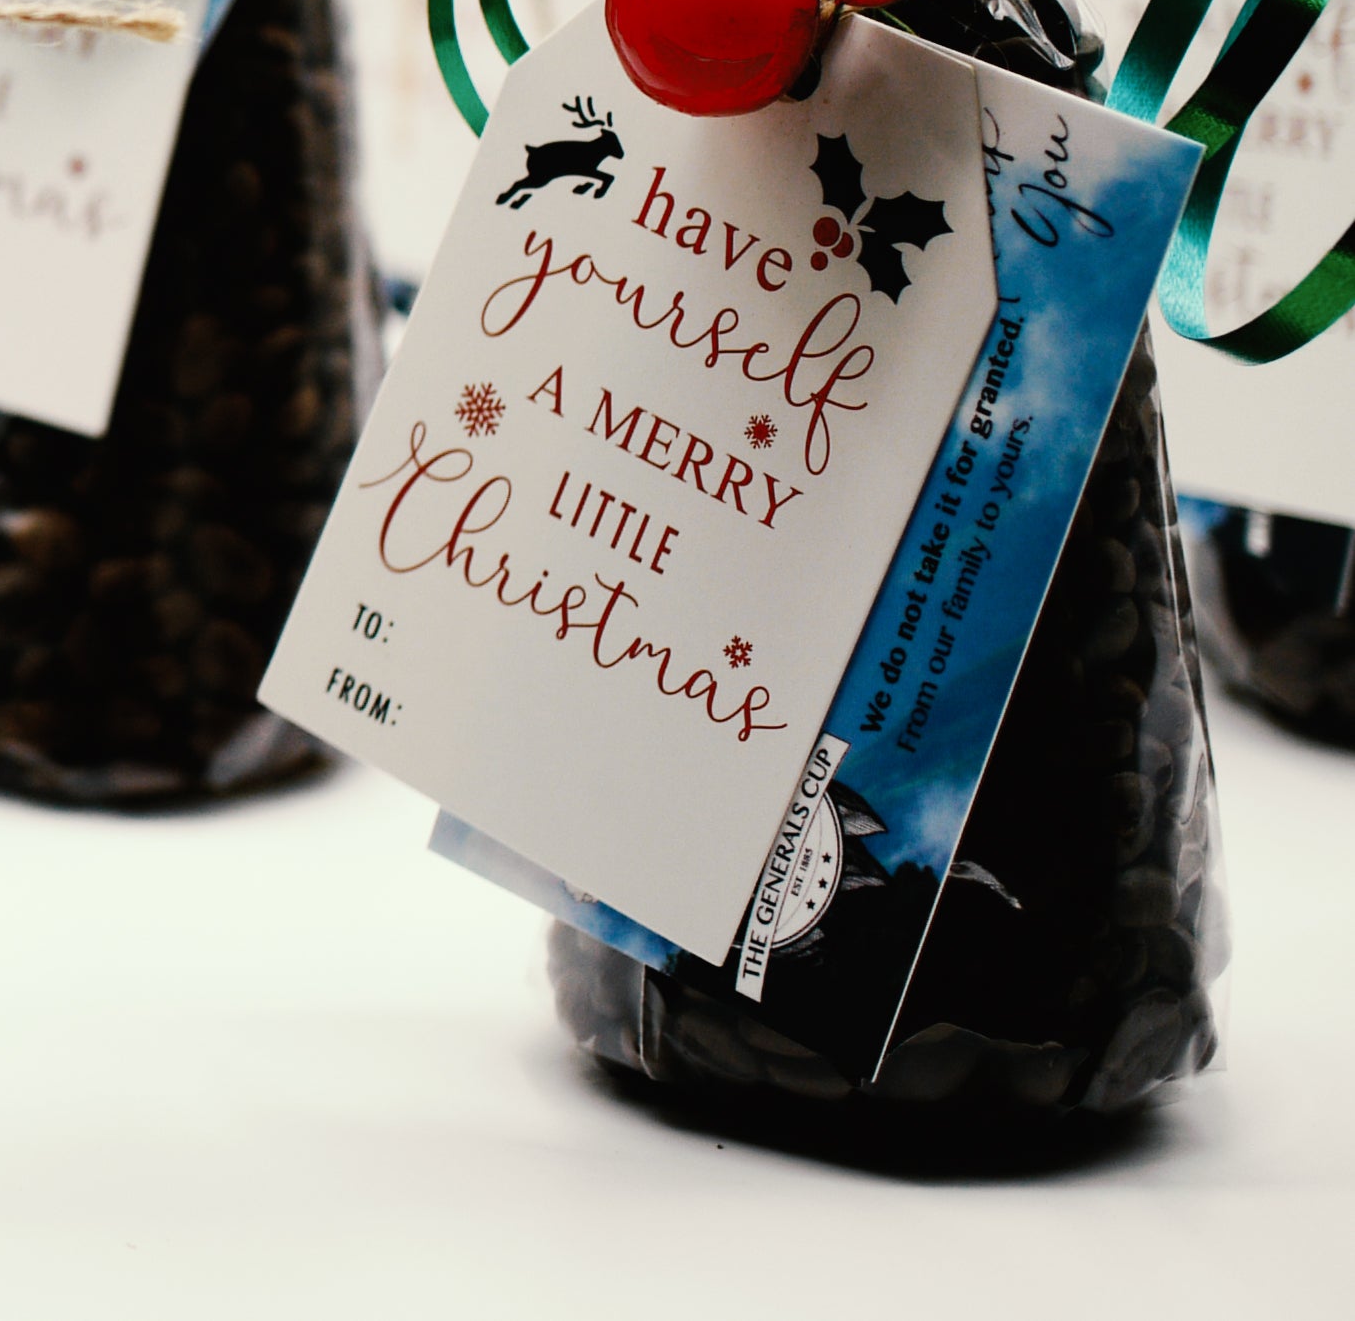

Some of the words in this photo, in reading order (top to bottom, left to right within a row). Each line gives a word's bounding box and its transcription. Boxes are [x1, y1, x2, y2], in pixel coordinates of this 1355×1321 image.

[631, 166, 793, 291] have
[481, 229, 875, 476] yourself
[969, 316, 1025, 441] granted.
[526, 364, 565, 418] A
[584, 387, 805, 531] MERRY
[946, 439, 978, 488] for
[990, 415, 1034, 500] yours.
[547, 470, 681, 576] LITTLE
[934, 492, 962, 517] it
[975, 501, 1000, 531] to
[358, 421, 788, 743] Christmas
[914, 522, 950, 585] take
[942, 536, 992, 621] family
[350, 602, 396, 645] TO:
[897, 589, 927, 642] not
[879, 646, 907, 685] do
[929, 625, 956, 675] our
[325, 667, 404, 728] FROM:
[859, 689, 892, 733] We
[897, 680, 938, 754] From
[742, 929, 769, 979] THE
[756, 801, 811, 926] GENERALS
[801, 747, 833, 799] CUP
